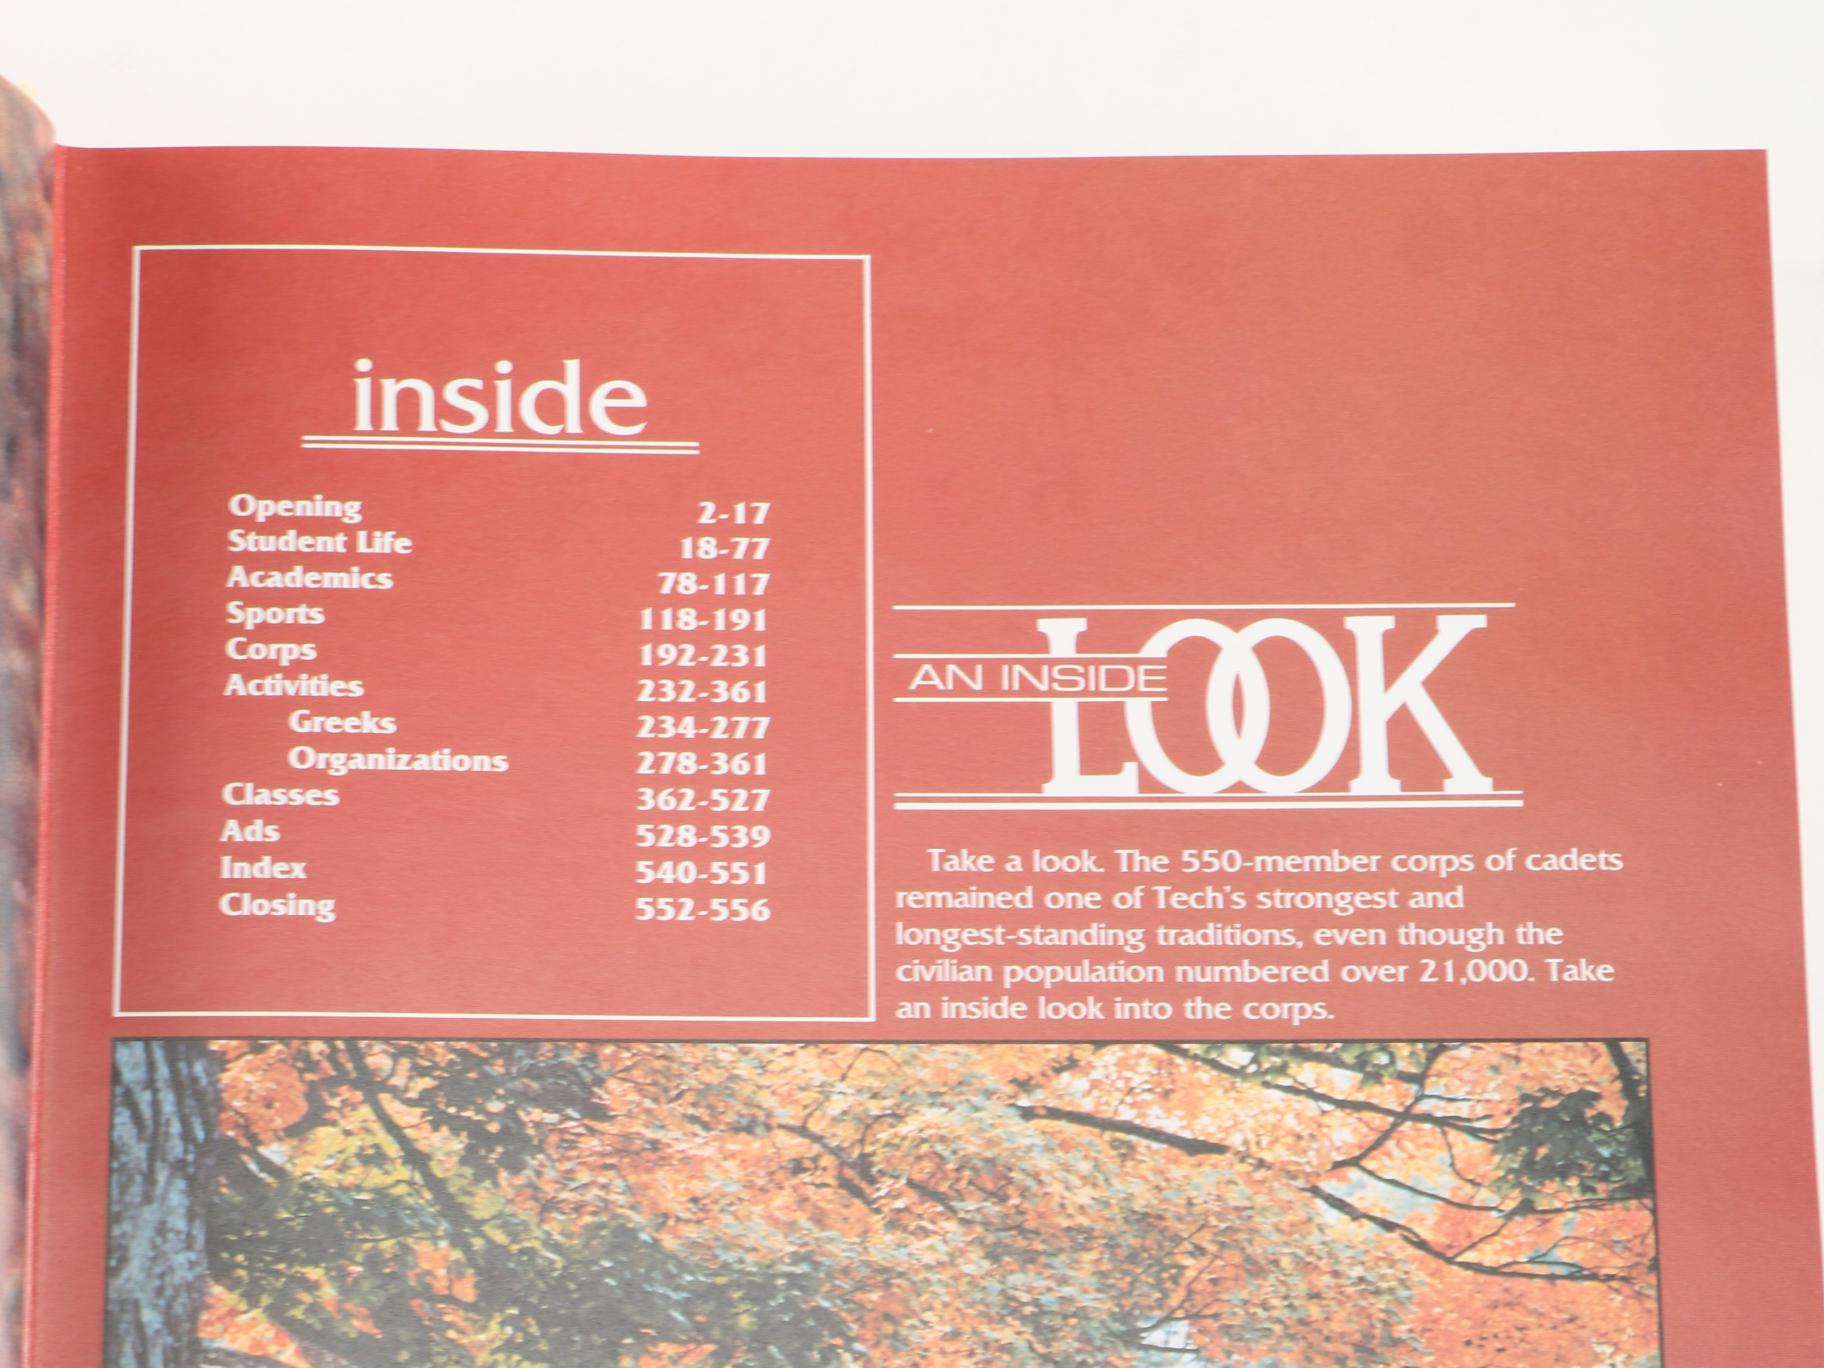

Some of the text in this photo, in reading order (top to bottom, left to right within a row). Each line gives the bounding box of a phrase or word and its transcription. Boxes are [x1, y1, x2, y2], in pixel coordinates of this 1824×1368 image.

[350, 356, 650, 434] inside
[229, 494, 362, 523] Opening
[698, 501, 770, 524] 2-17
[228, 529, 412, 554] Student Life
[682, 537, 770, 559] 18-77
[226, 565, 393, 589] Academics
[658, 572, 770, 595] 78-117
[226, 601, 325, 629] Sports
[641, 608, 765, 631] 118-191
[225, 637, 317, 665] Corps
[640, 644, 765, 667] 192-231
[224, 673, 364, 697] Activities
[908, 661, 1168, 694] AN INSIDE
[637, 679, 765, 703] 232-361
[1036, 614, 1494, 794] LOOK
[289, 710, 397, 733] Greeks
[637, 715, 770, 739] 234-277
[288, 746, 509, 776] Organizations
[637, 751, 765, 775] 278-361
[222, 782, 340, 806] Classes
[637, 788, 770, 811] 362-527
[220, 819, 280, 842] Ads
[637, 824, 771, 848] 528-539
[221, 856, 306, 878] Index
[636, 861, 765, 884] 540-551
[927, 848, 1623, 877] Take a look. The 550-member corps of cadets
[219, 893, 336, 922] Closing
[636, 898, 771, 921] 552-556
[896, 885, 1464, 916] remained one of Tech's strongest and
[896, 922, 1563, 953] longest-standing traditions, even though the
[896, 959, 1614, 988] civilian population numbered over 21,000. Take
[896, 995, 1334, 1025] an inside look into the corps.
